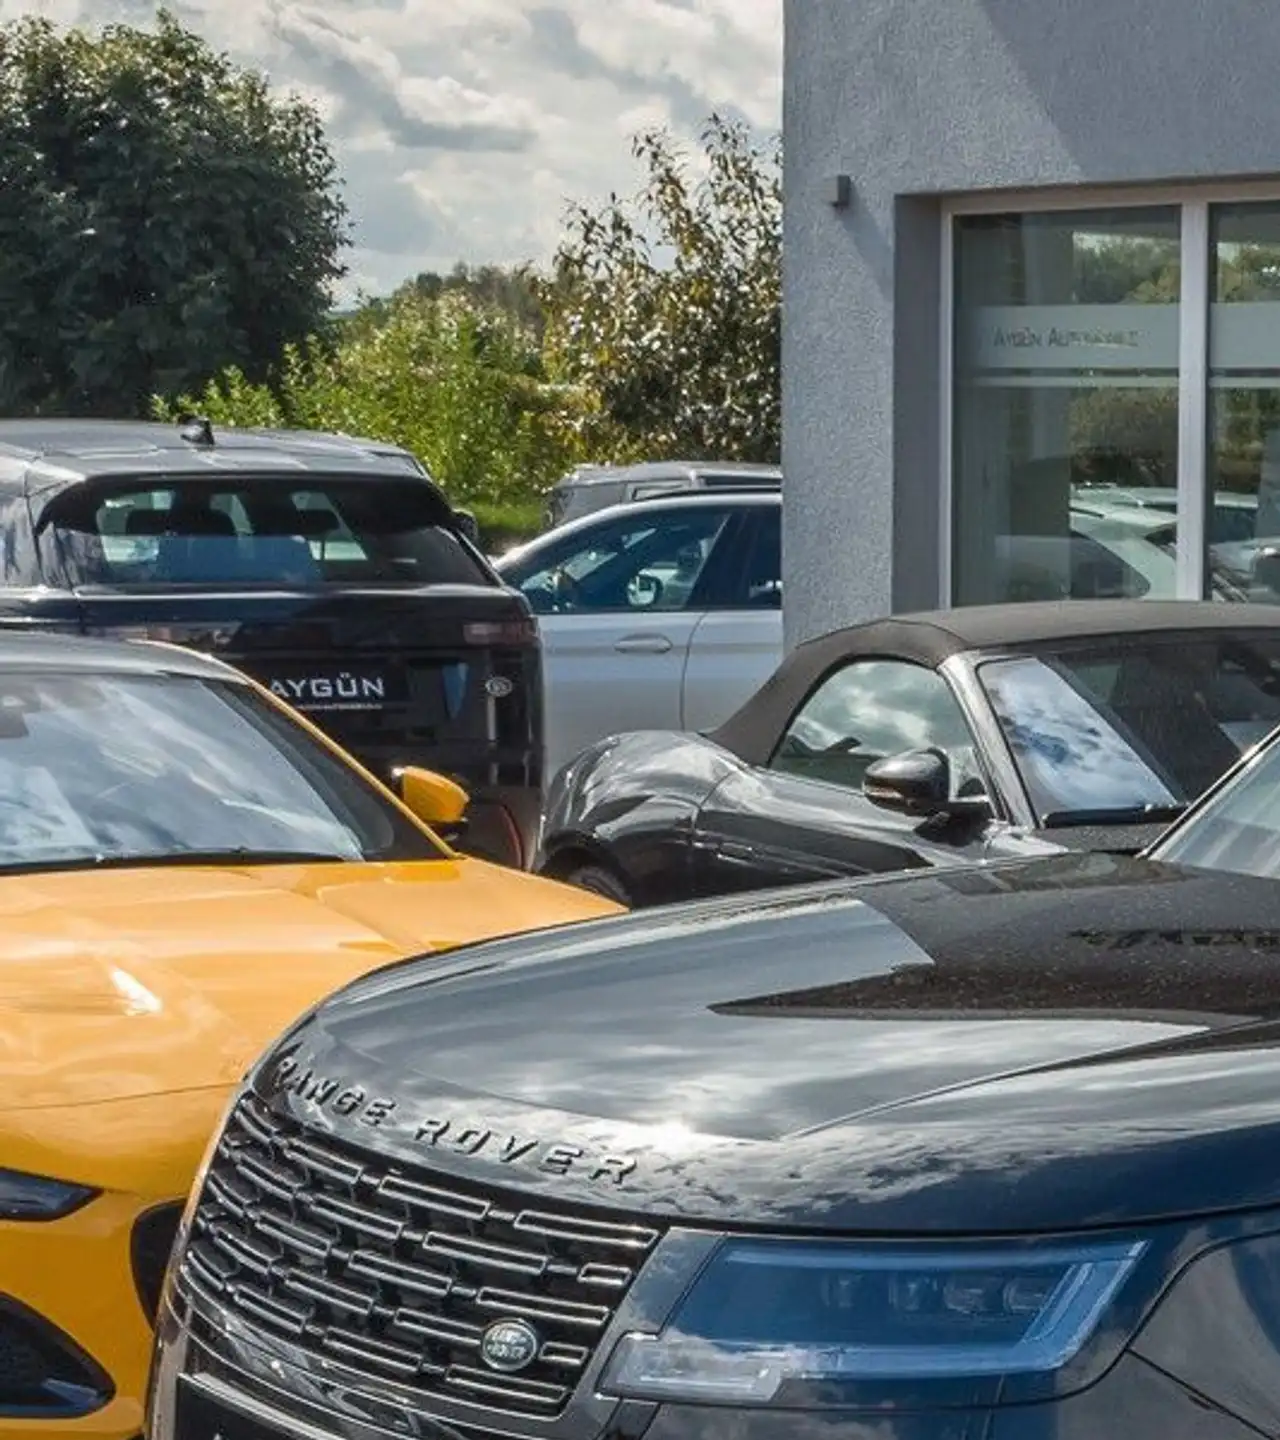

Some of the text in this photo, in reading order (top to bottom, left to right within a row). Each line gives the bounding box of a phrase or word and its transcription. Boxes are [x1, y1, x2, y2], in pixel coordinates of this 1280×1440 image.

[270, 671, 385, 698] AYGÜN
[274, 1055, 639, 1186] RANGE ROVER
